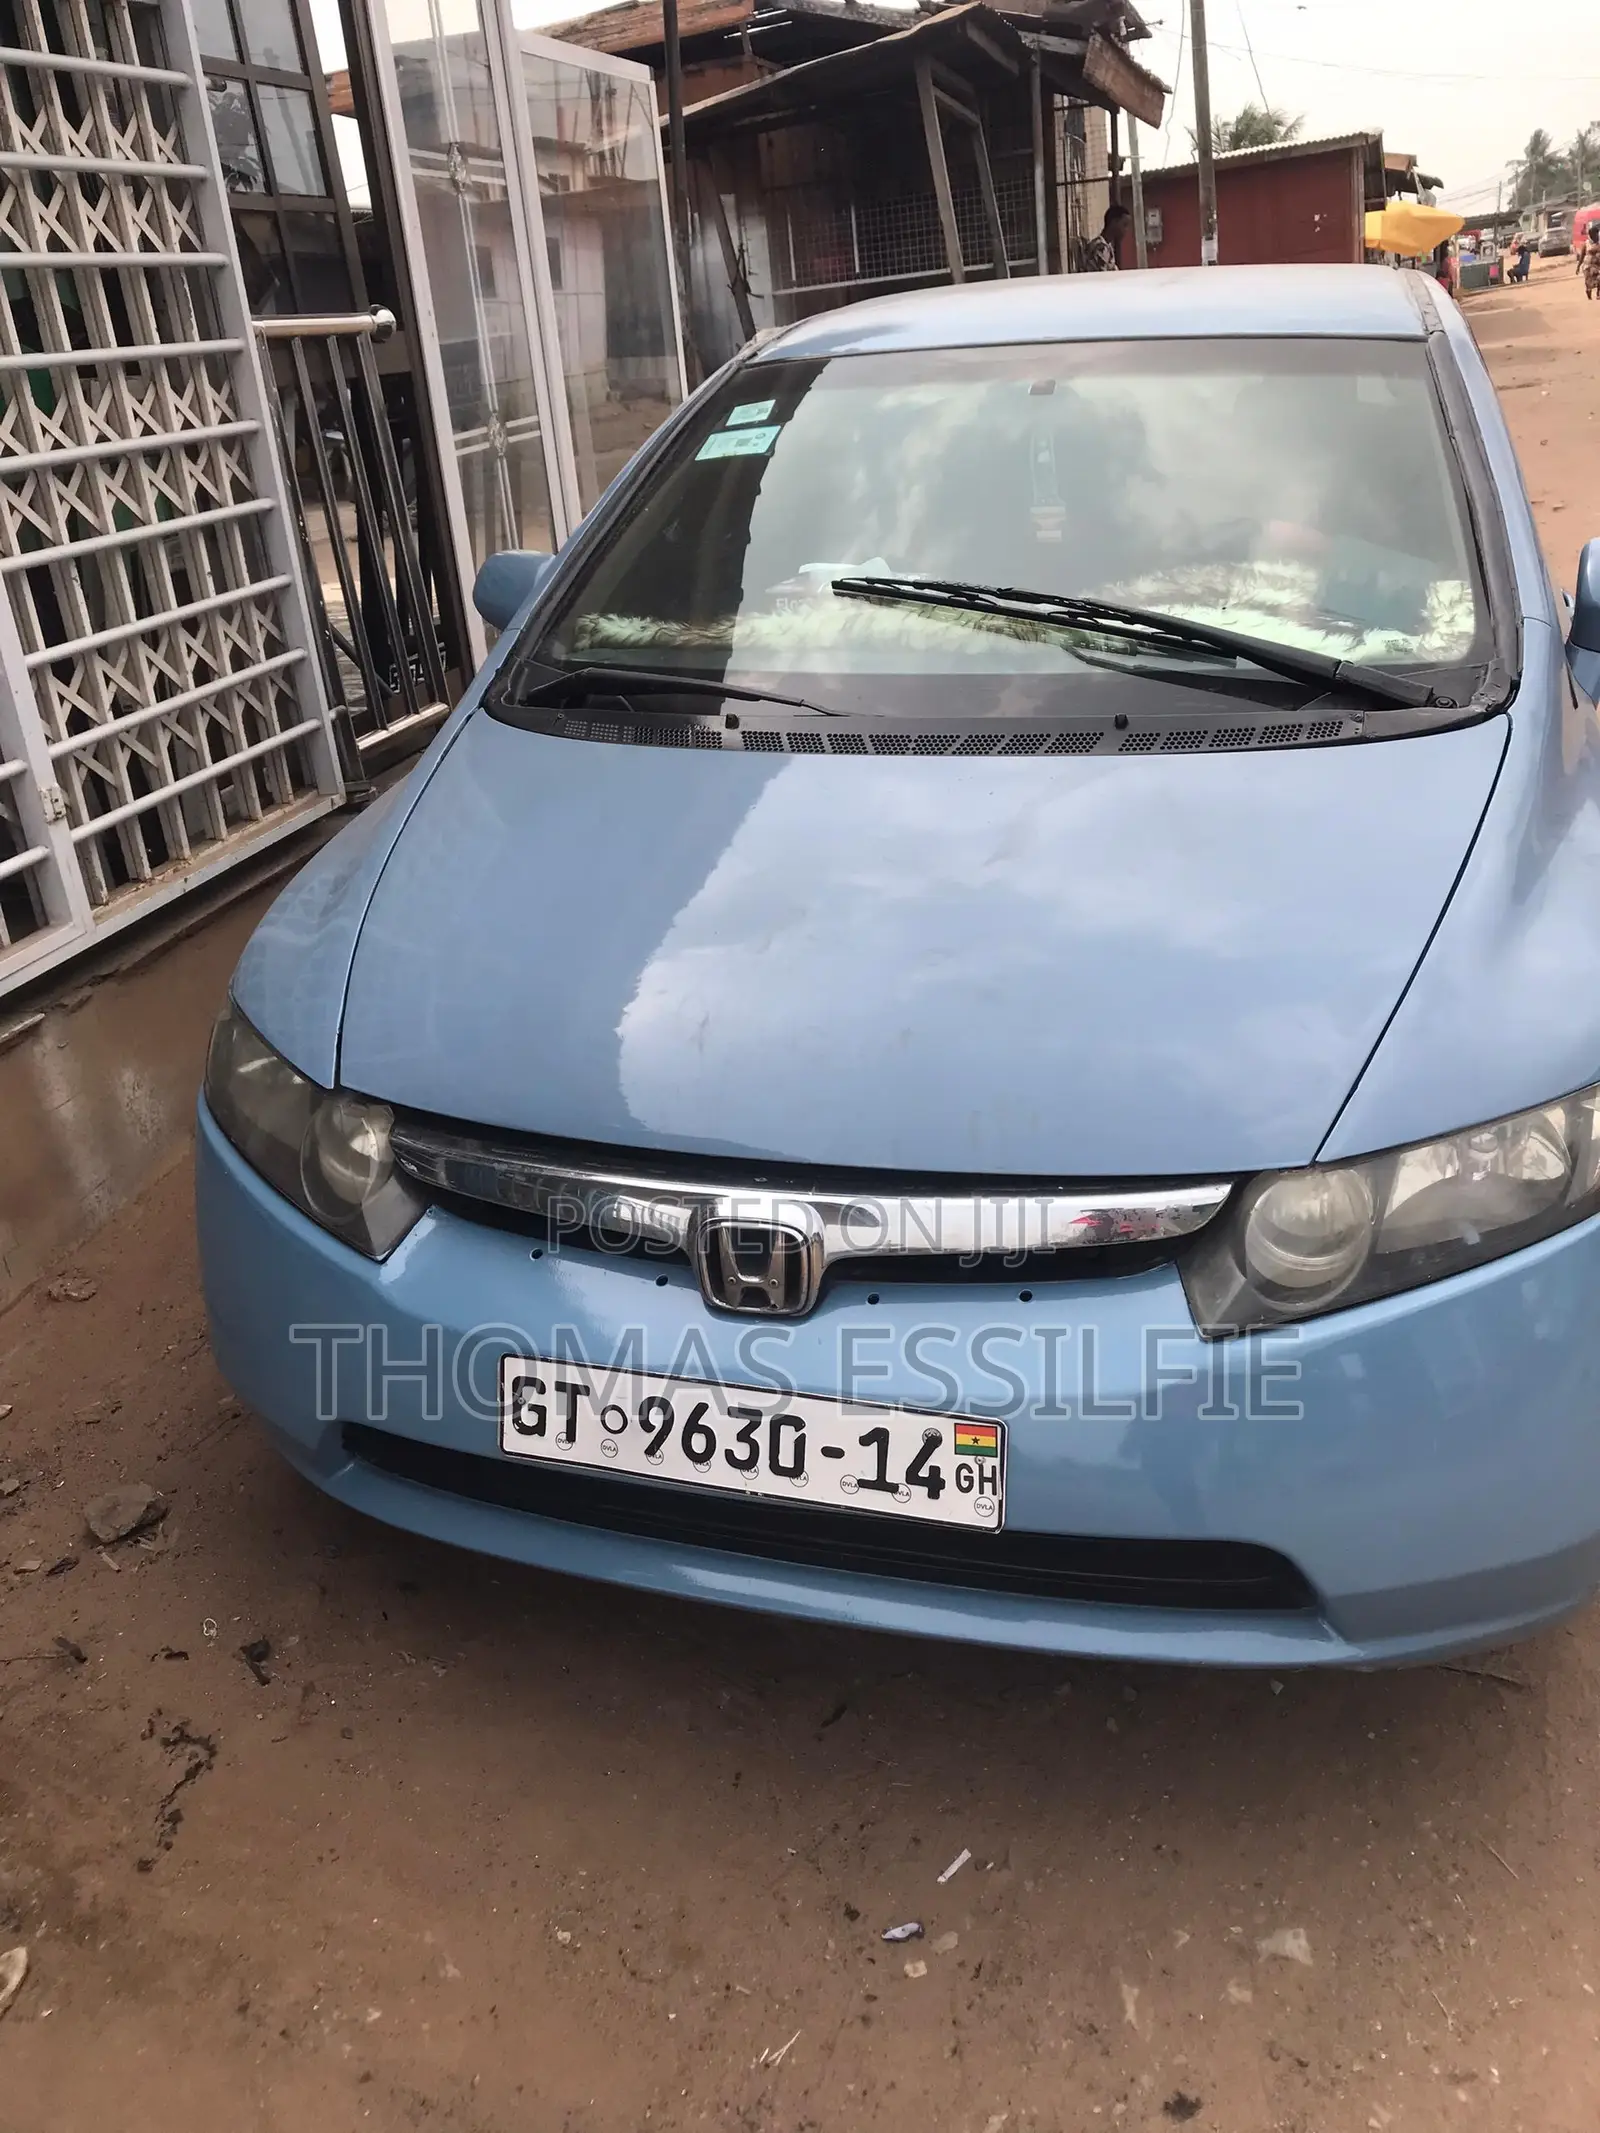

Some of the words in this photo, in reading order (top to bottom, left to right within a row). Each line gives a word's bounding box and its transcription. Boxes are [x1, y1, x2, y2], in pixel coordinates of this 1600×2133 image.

[512, 1376, 591, 1444] GT
[602, 1444, 617, 1453] DVLA
[955, 1463, 998, 1497] GH
[976, 1503, 993, 1511] DVLA
